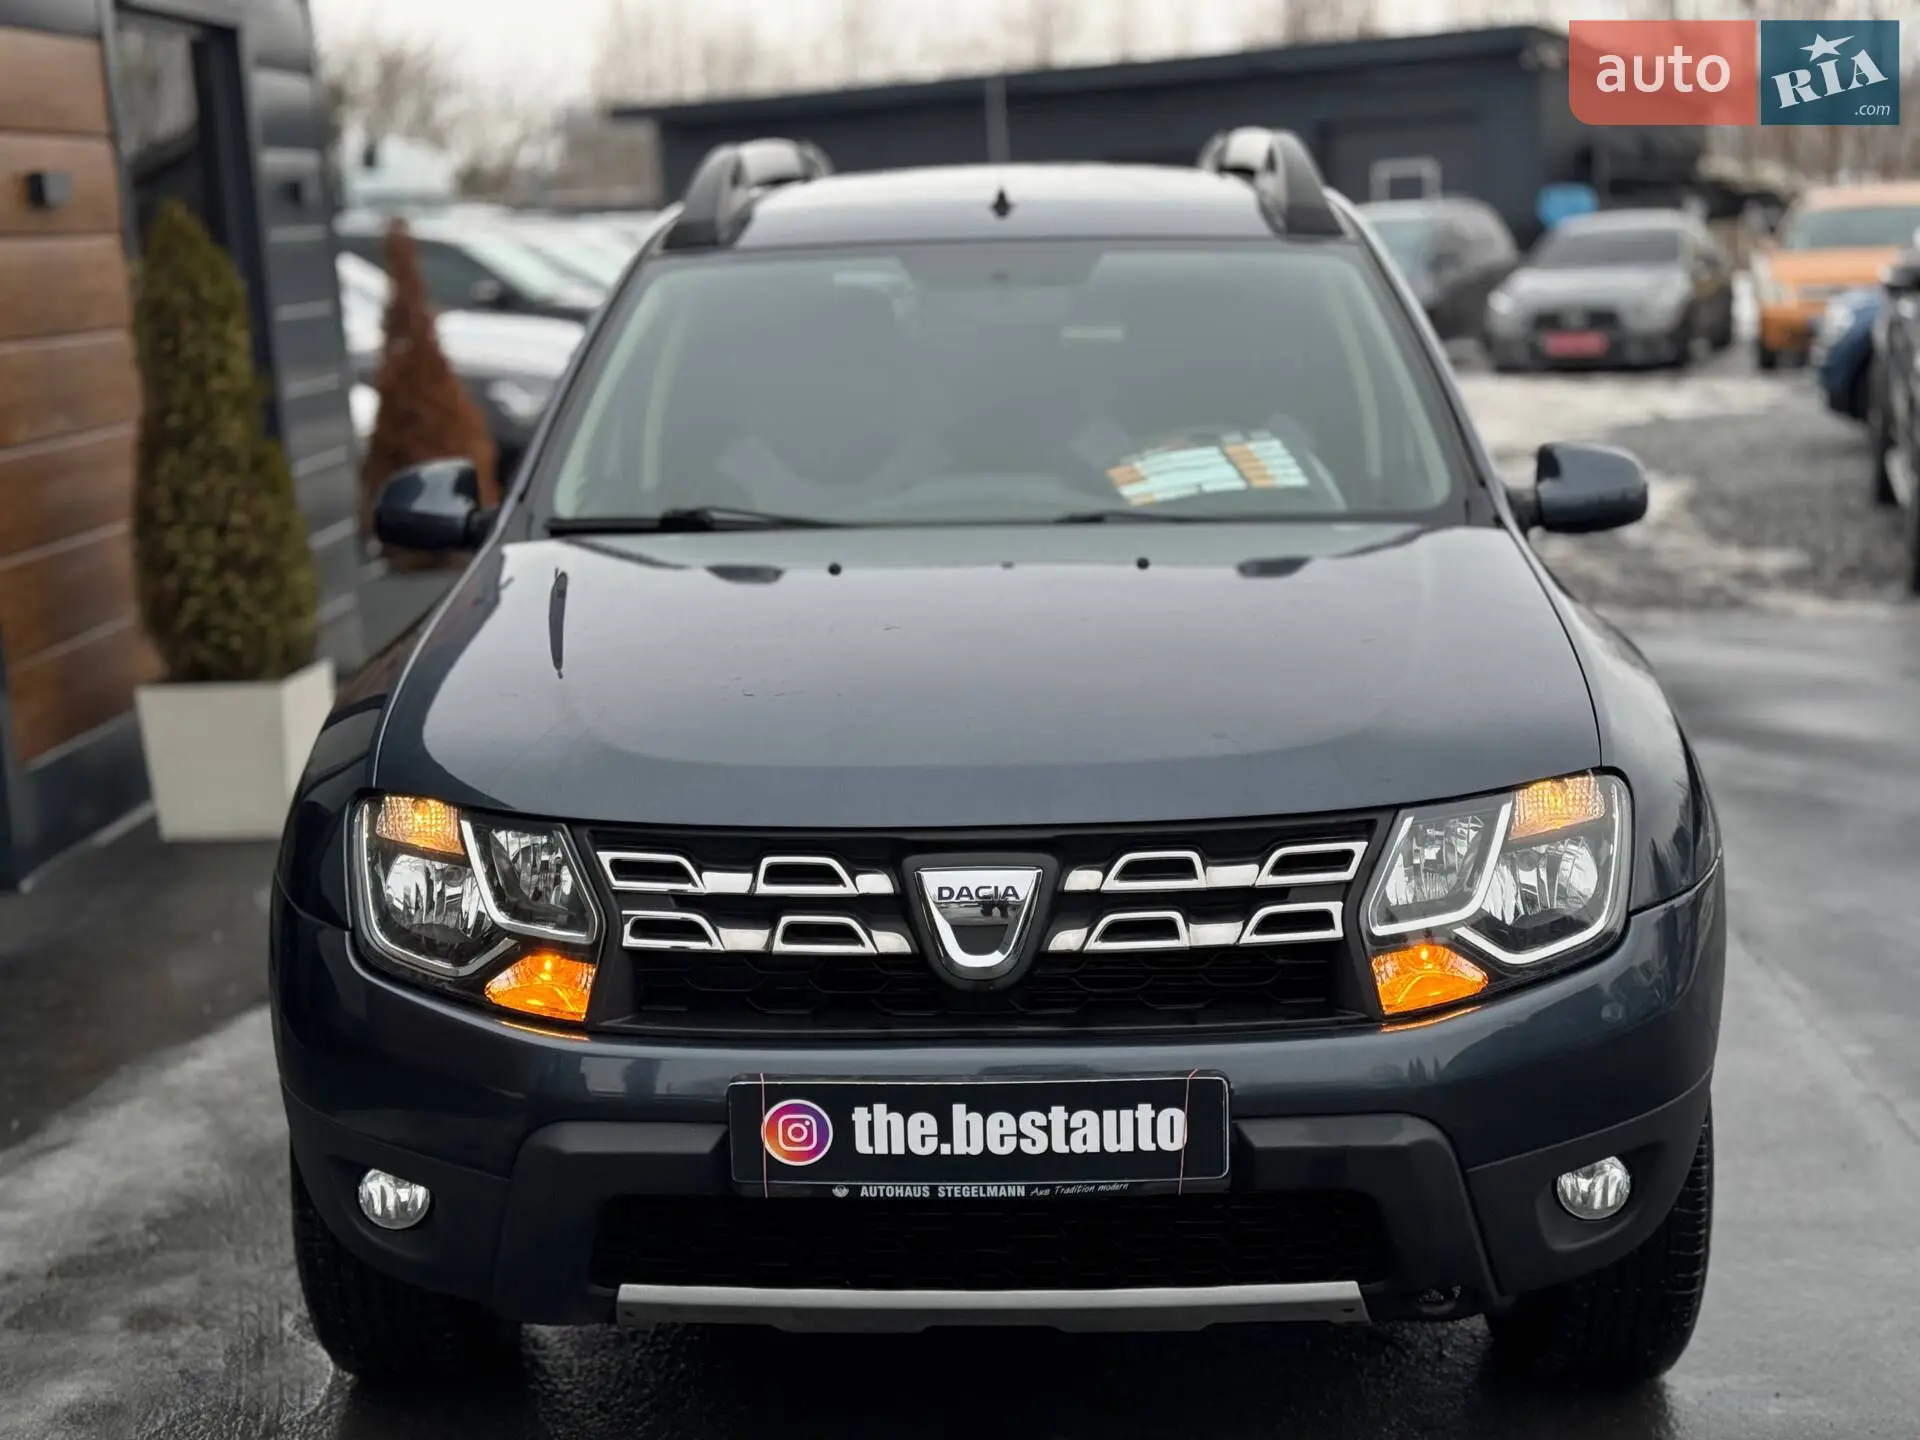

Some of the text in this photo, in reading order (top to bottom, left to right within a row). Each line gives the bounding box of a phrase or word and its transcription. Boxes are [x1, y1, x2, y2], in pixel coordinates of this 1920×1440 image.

[937, 886, 1020, 901] DACIA
[852, 1103, 1188, 1155] the.bestauto
[860, 1185, 930, 1198] AUTOHAUS
[938, 1185, 1026, 1197] STEGELMANN
[1055, 1185, 1095, 1195] Tradition
[1098, 1183, 1129, 1192] modern
